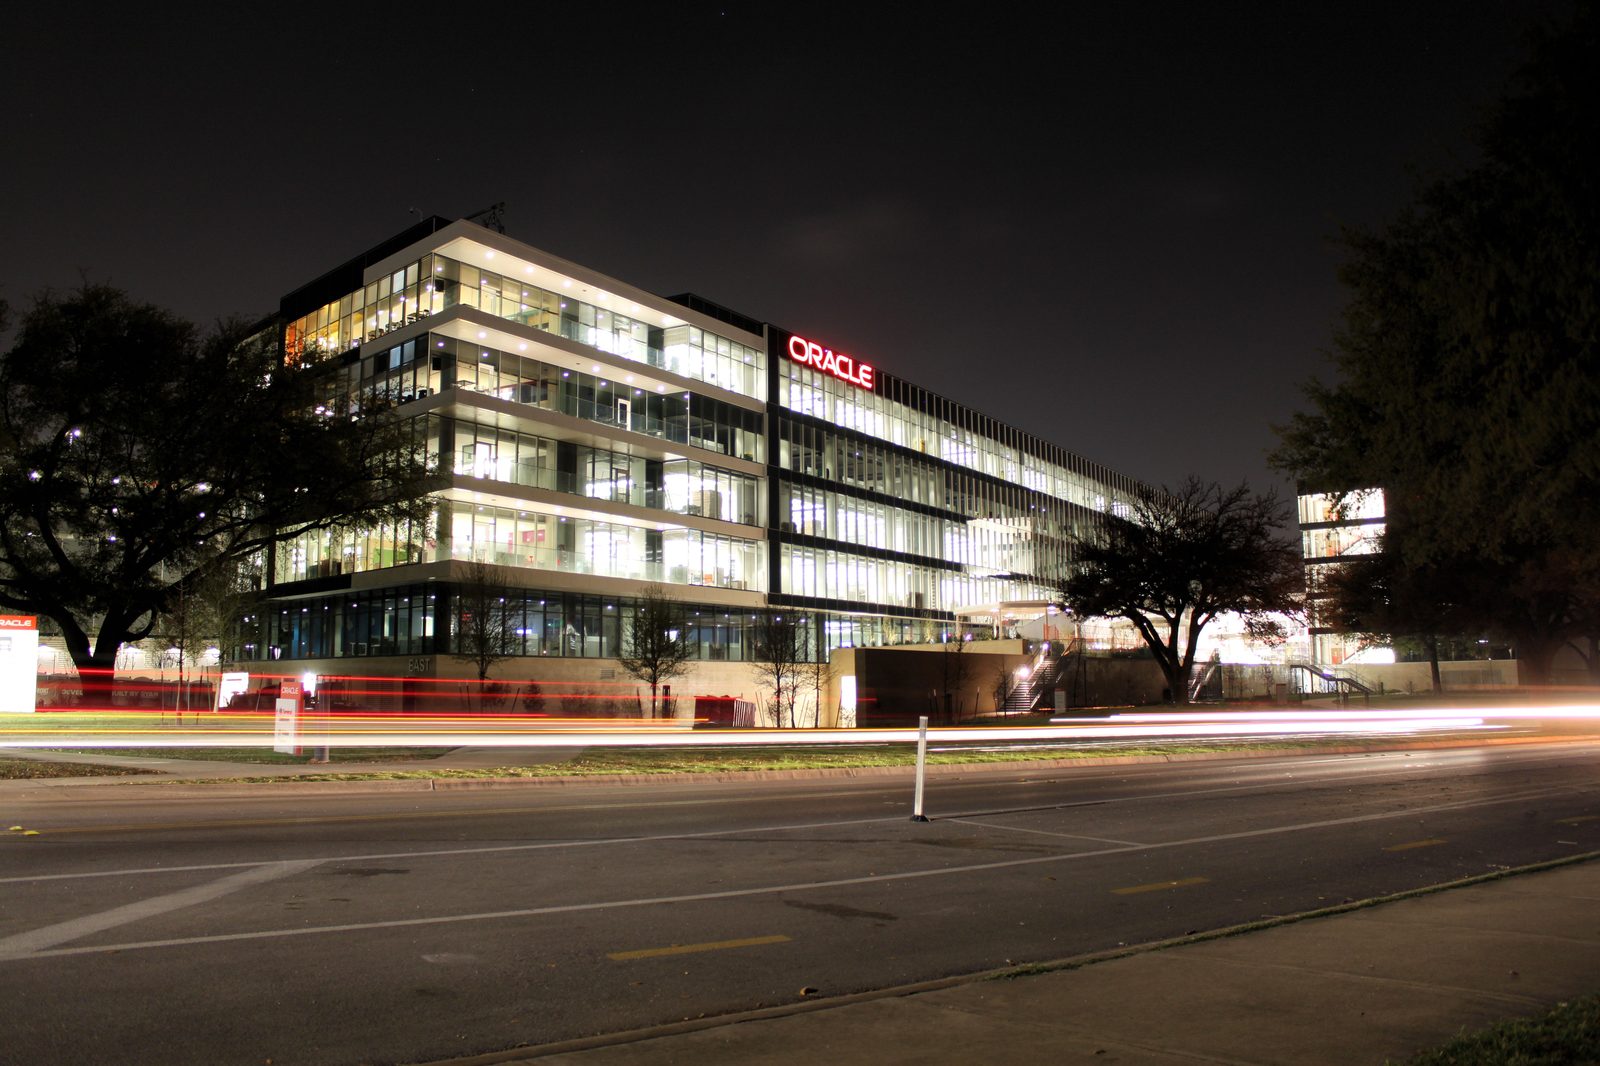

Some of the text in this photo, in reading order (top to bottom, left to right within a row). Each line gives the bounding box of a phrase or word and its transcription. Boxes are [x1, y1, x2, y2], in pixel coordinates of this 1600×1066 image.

[789, 335, 873, 388] ORACLE
[0, 619, 32, 627] RACLE
[408, 658, 430, 672] EAST
[281, 686, 299, 695] ORACLE
